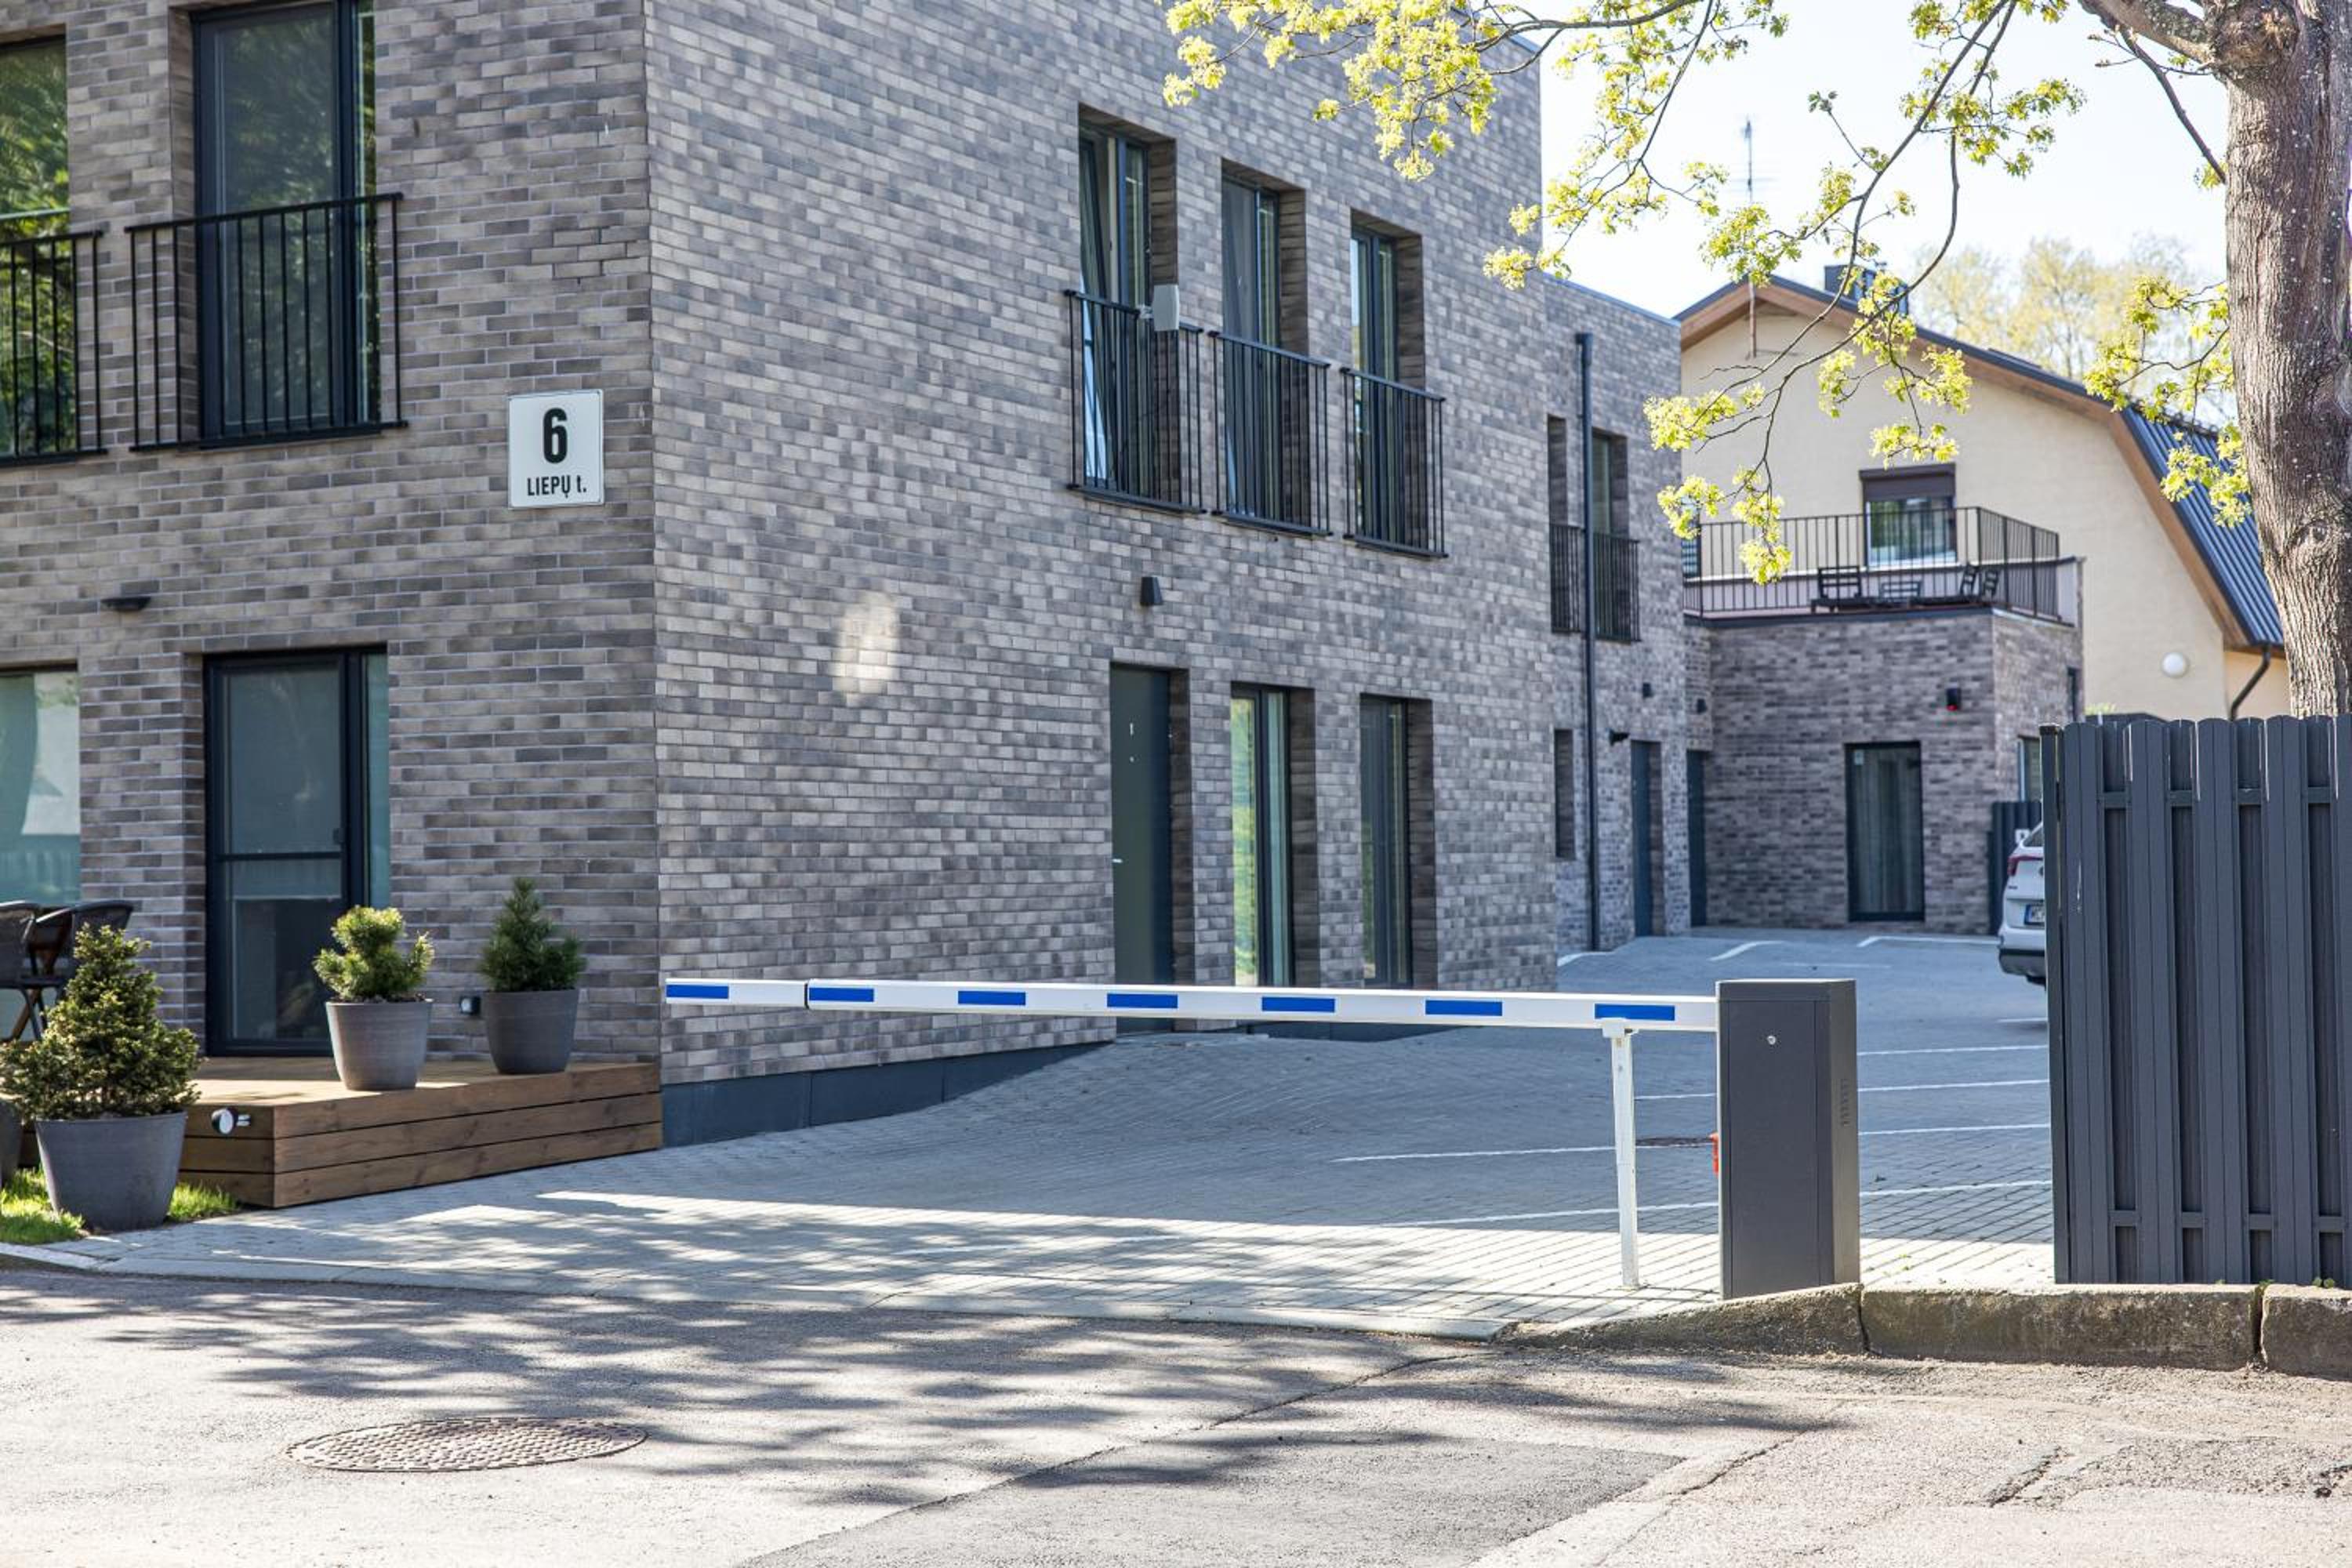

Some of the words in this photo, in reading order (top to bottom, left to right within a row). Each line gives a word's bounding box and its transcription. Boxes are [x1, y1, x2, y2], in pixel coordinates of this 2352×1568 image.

[543, 407, 568, 464] 6
[527, 474, 571, 499] LIEPŲ
[576, 474, 587, 493] t.
